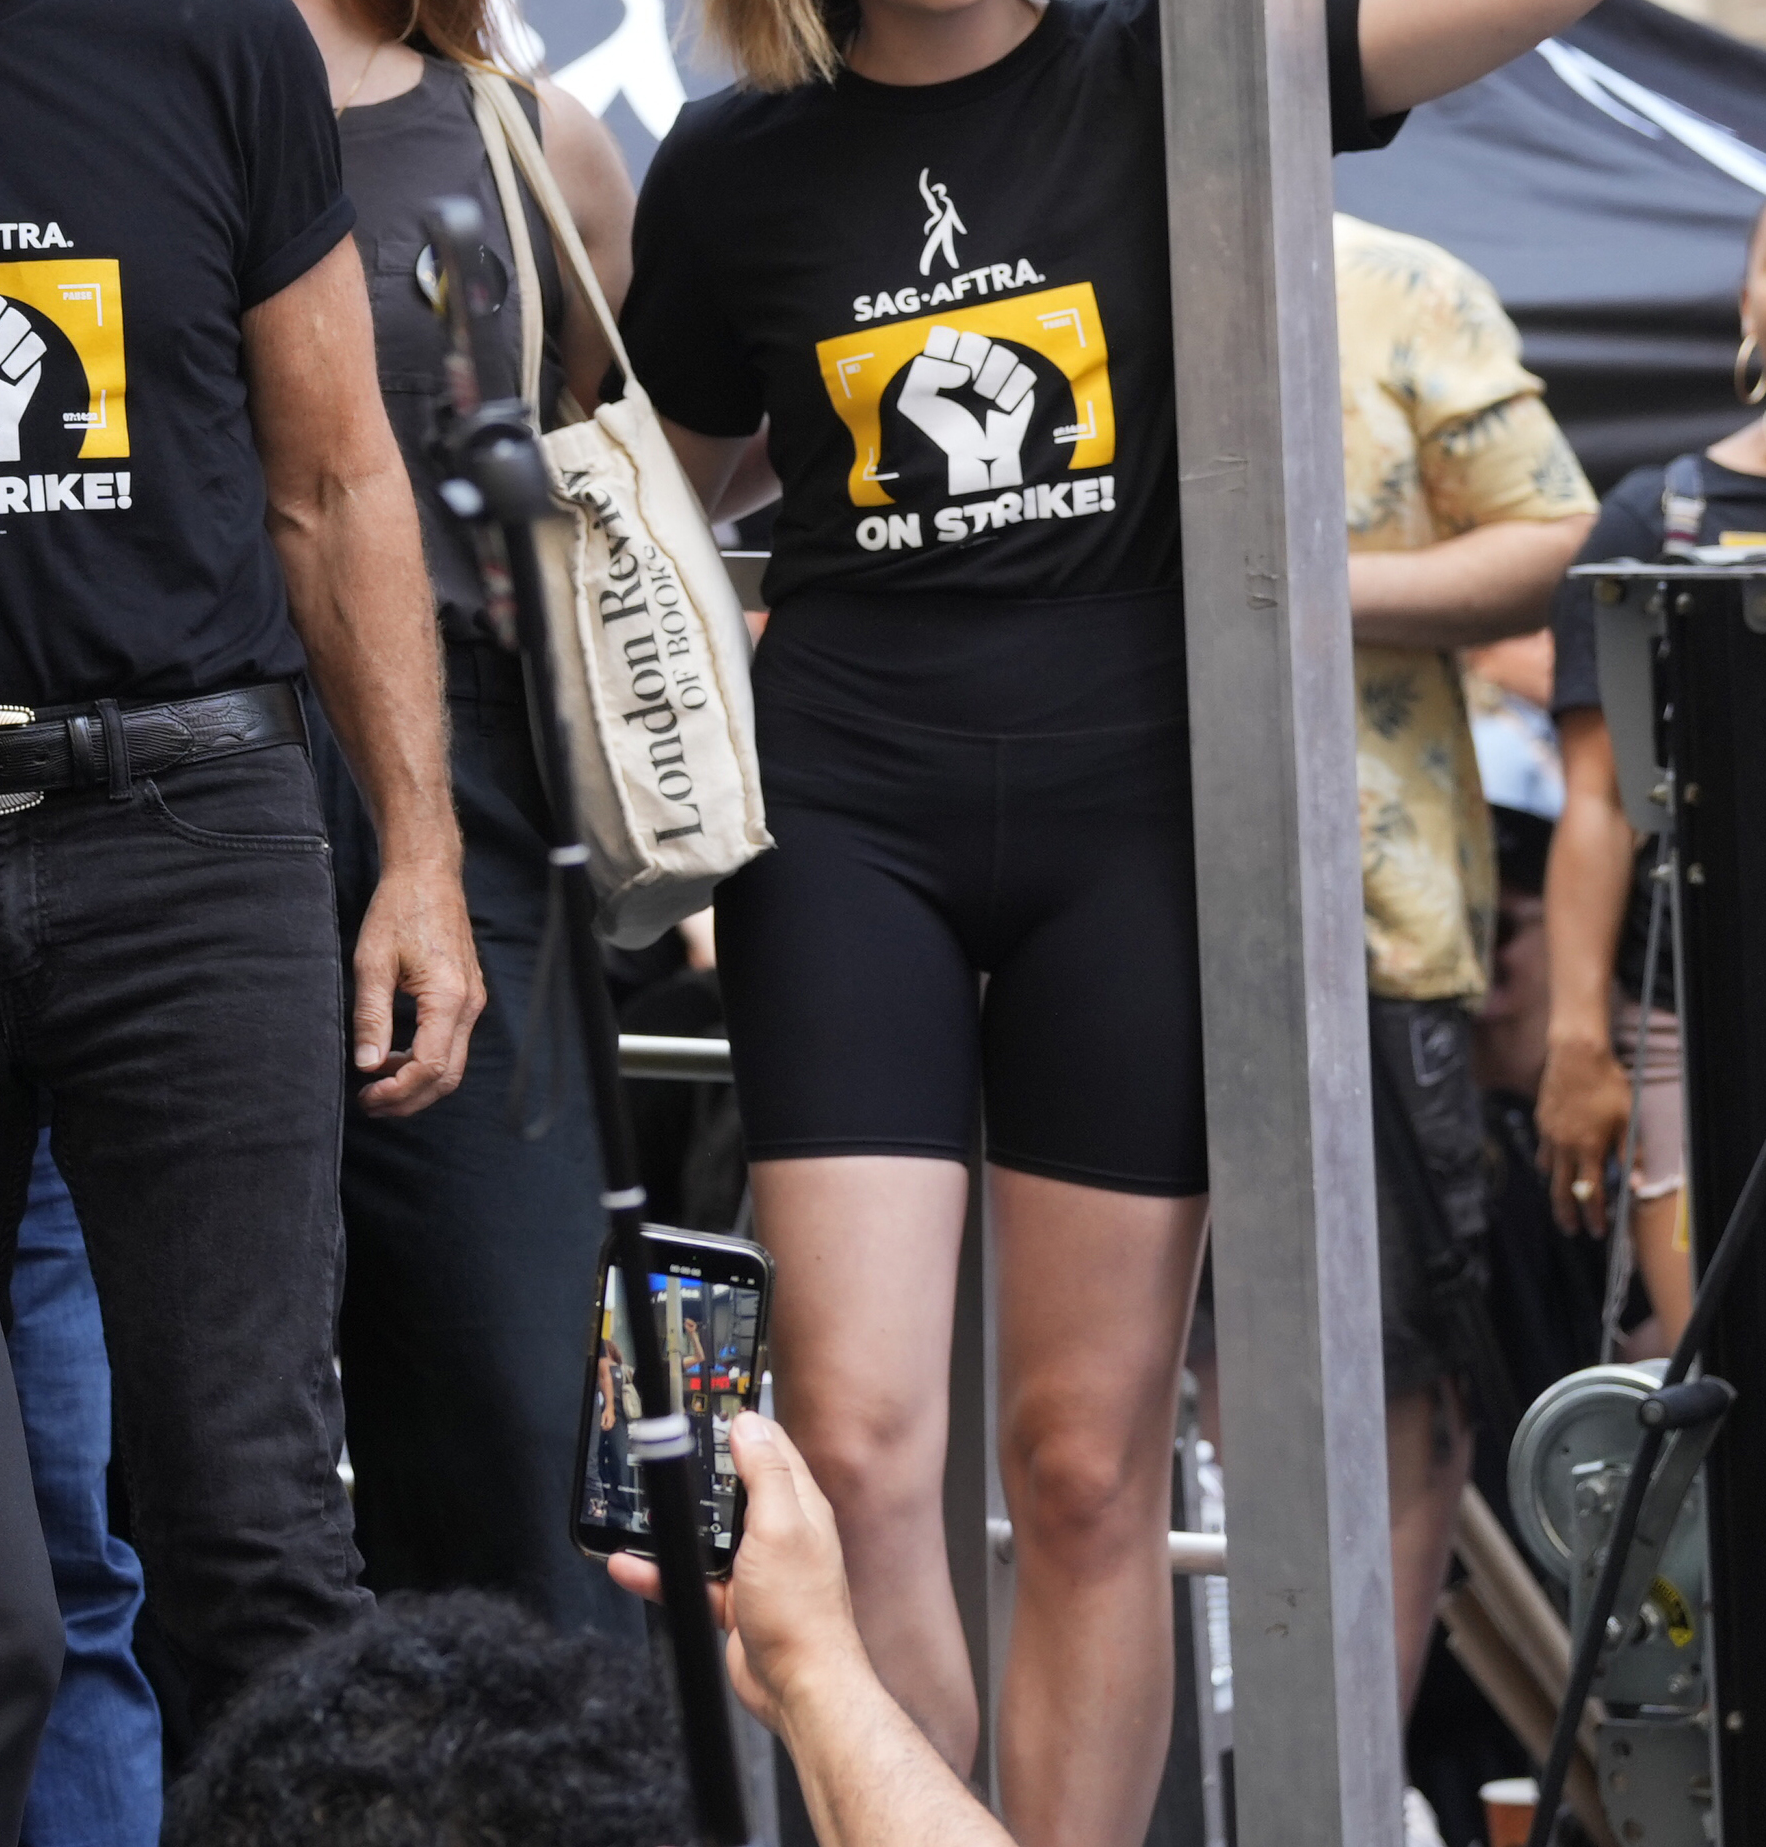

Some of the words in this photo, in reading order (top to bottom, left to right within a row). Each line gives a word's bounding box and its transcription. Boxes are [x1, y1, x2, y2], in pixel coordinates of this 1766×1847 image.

[559, 467, 653, 629] Review
[856, 513, 923, 551] ON
[934, 475, 1116, 543] STRIKE!
[623, 628, 705, 846] London
[671, 669, 707, 710] OF
